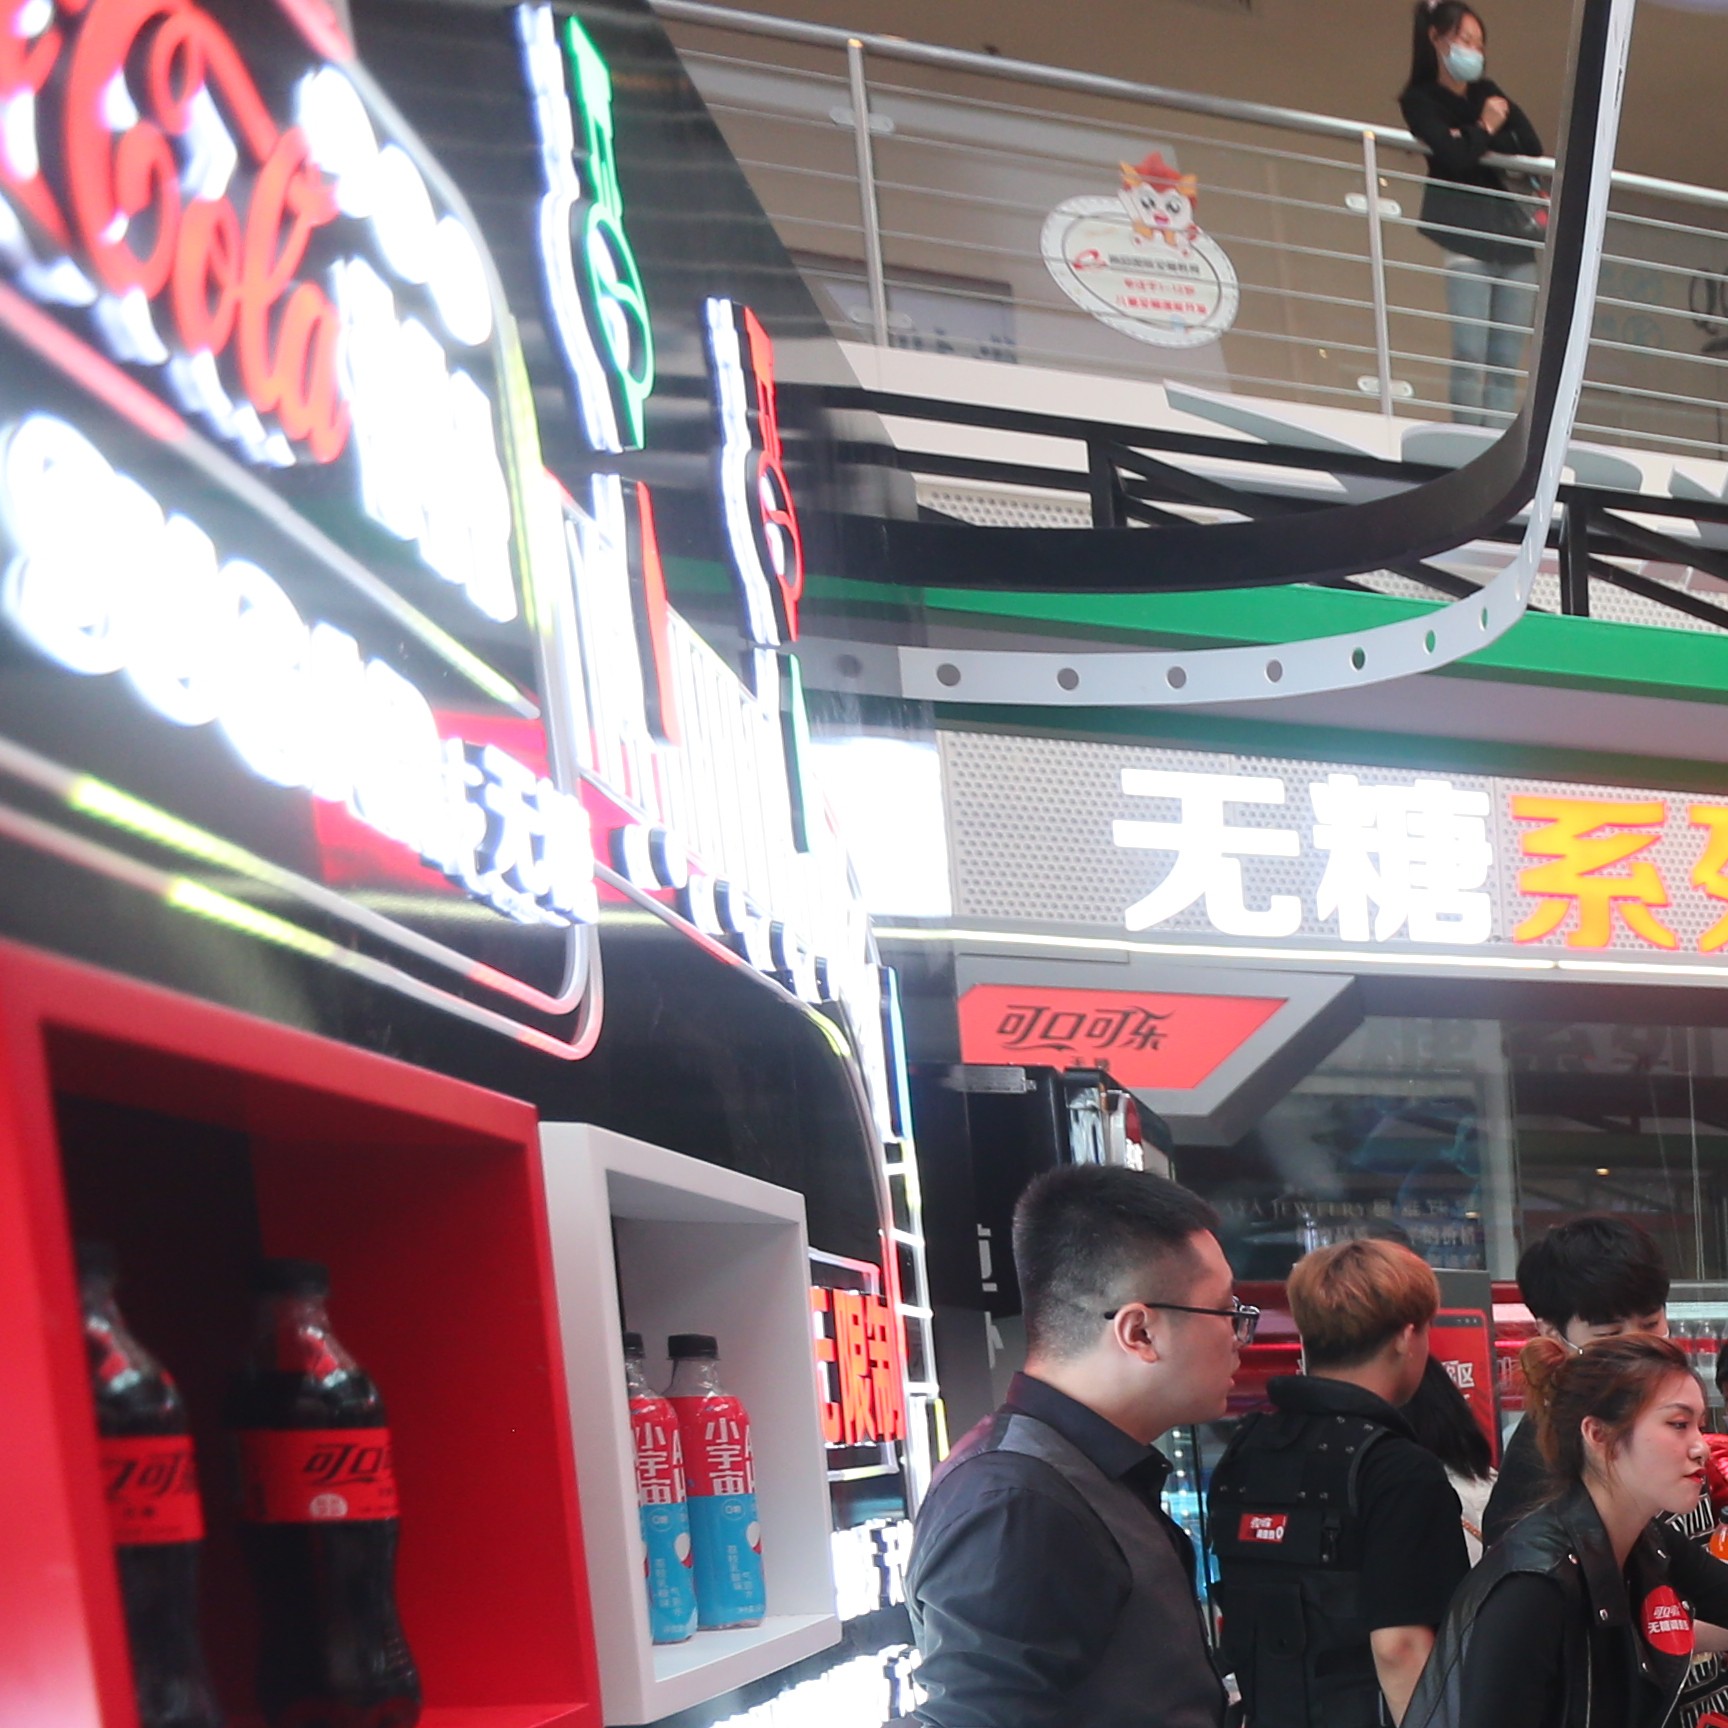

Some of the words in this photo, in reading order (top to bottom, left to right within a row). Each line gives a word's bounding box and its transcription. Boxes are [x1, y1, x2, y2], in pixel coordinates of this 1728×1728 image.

[996, 1004, 1177, 1051] 可口可乐
[635, 1421, 672, 1505] 小宇宙
[704, 1416, 745, 1497] 小宇宙
